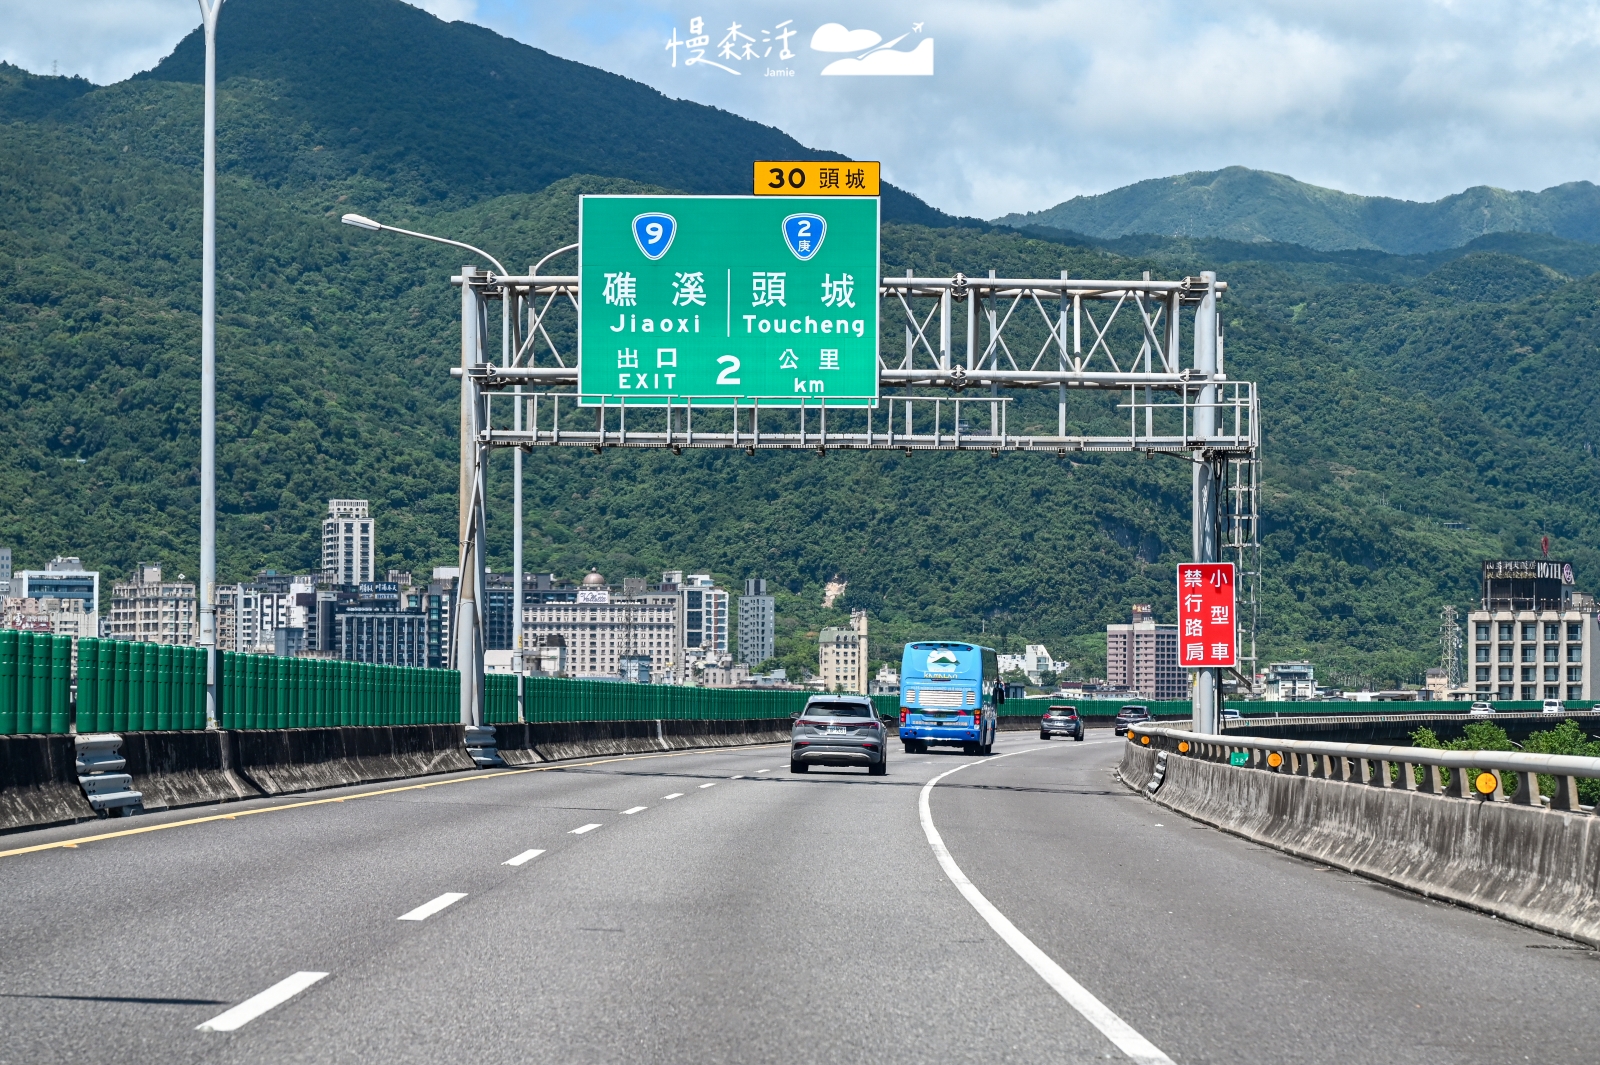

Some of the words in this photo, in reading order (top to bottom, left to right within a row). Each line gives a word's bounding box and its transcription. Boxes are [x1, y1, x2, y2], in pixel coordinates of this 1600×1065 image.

[768, 167, 806, 189] 30
[819, 167, 866, 189] 頭城
[645, 222, 664, 245] 9
[797, 220, 812, 237] 2
[797, 240, 812, 252] 庚
[602, 271, 707, 307] 礁溪
[751, 271, 856, 308] 頭城
[610, 314, 701, 333] Jiaoxi
[743, 314, 865, 338] Toucheng
[617, 347, 678, 369] 出口
[778, 348, 840, 371] 公里
[618, 373, 677, 389] EXIT
[715, 354, 742, 386] 2
[793, 377, 825, 393] km
[1538, 562, 1561, 579] HOTEL
[1184, 569, 1204, 661] 禁行路肩
[1210, 569, 1229, 661] 小型車
